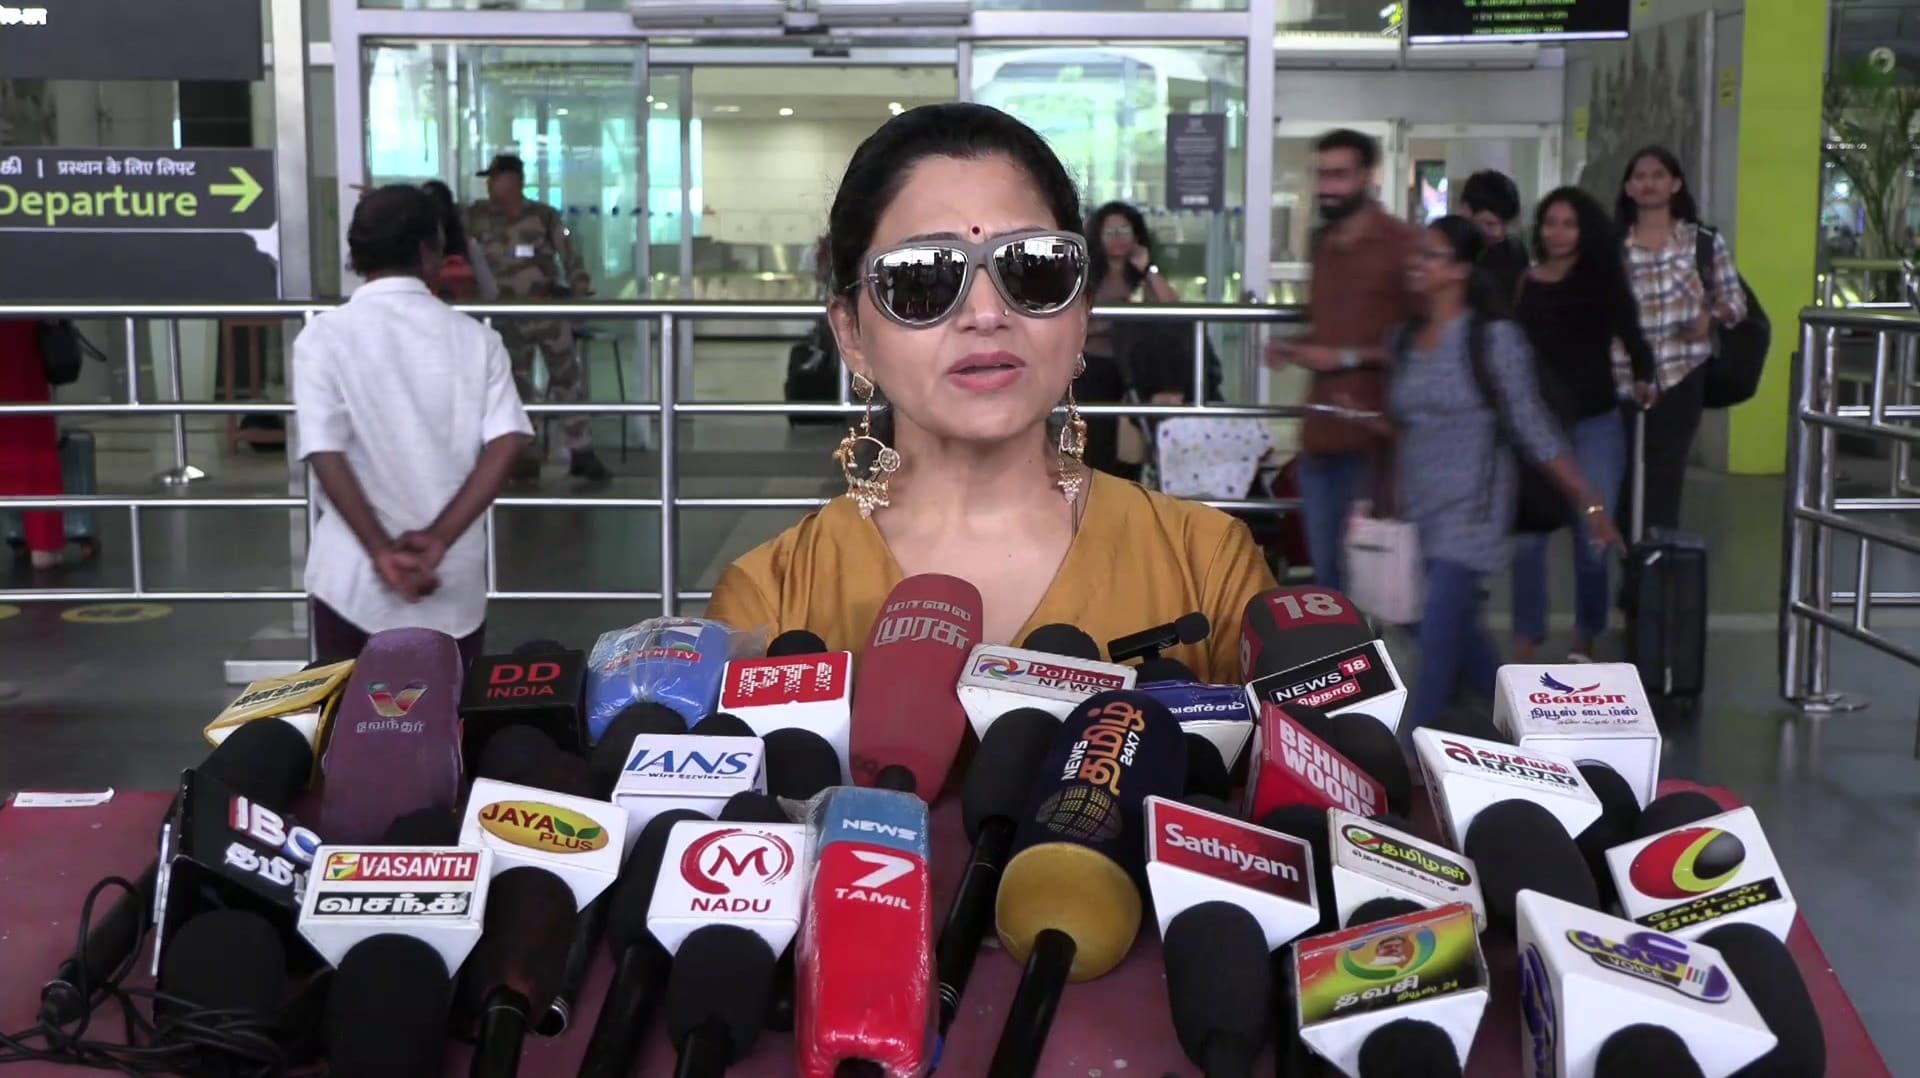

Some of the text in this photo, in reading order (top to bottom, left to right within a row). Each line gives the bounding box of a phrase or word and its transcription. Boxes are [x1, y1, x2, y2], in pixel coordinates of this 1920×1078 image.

[57, 160, 103, 176] प्रस्थान
[106, 156, 122, 175] के
[125, 157, 153, 176] लिए
[0, 184, 198, 226] Departure
[1273, 593, 1343, 619] 18
[873, 616, 970, 650] முரசு
[676, 650, 694, 660] TV
[490, 662, 561, 684] DD
[737, 662, 833, 698] PTI
[1030, 662, 1121, 689] Polimer
[1275, 659, 1366, 702] NEWS 18
[487, 685, 554, 699] INDIA
[625, 749, 754, 775] IANS
[1061, 740, 1089, 780] NEWS
[1079, 701, 1146, 797] தமிழ்
[1119, 731, 1140, 767] 24X7
[1280, 718, 1376, 806] BEHIND
[1281, 741, 1377, 818] WOODS
[1486, 760, 1578, 788] TODAY
[229, 794, 323, 863] IBC
[482, 804, 555, 833] JAYA
[842, 818, 917, 841] NEWS
[539, 832, 593, 851] PLUS
[1165, 823, 1299, 882] Sathiyam
[224, 842, 312, 904] தமி
[361, 856, 473, 877] VASANTH
[850, 850, 916, 888] 7
[690, 898, 771, 913] NADU
[834, 888, 911, 910] TAMIL
